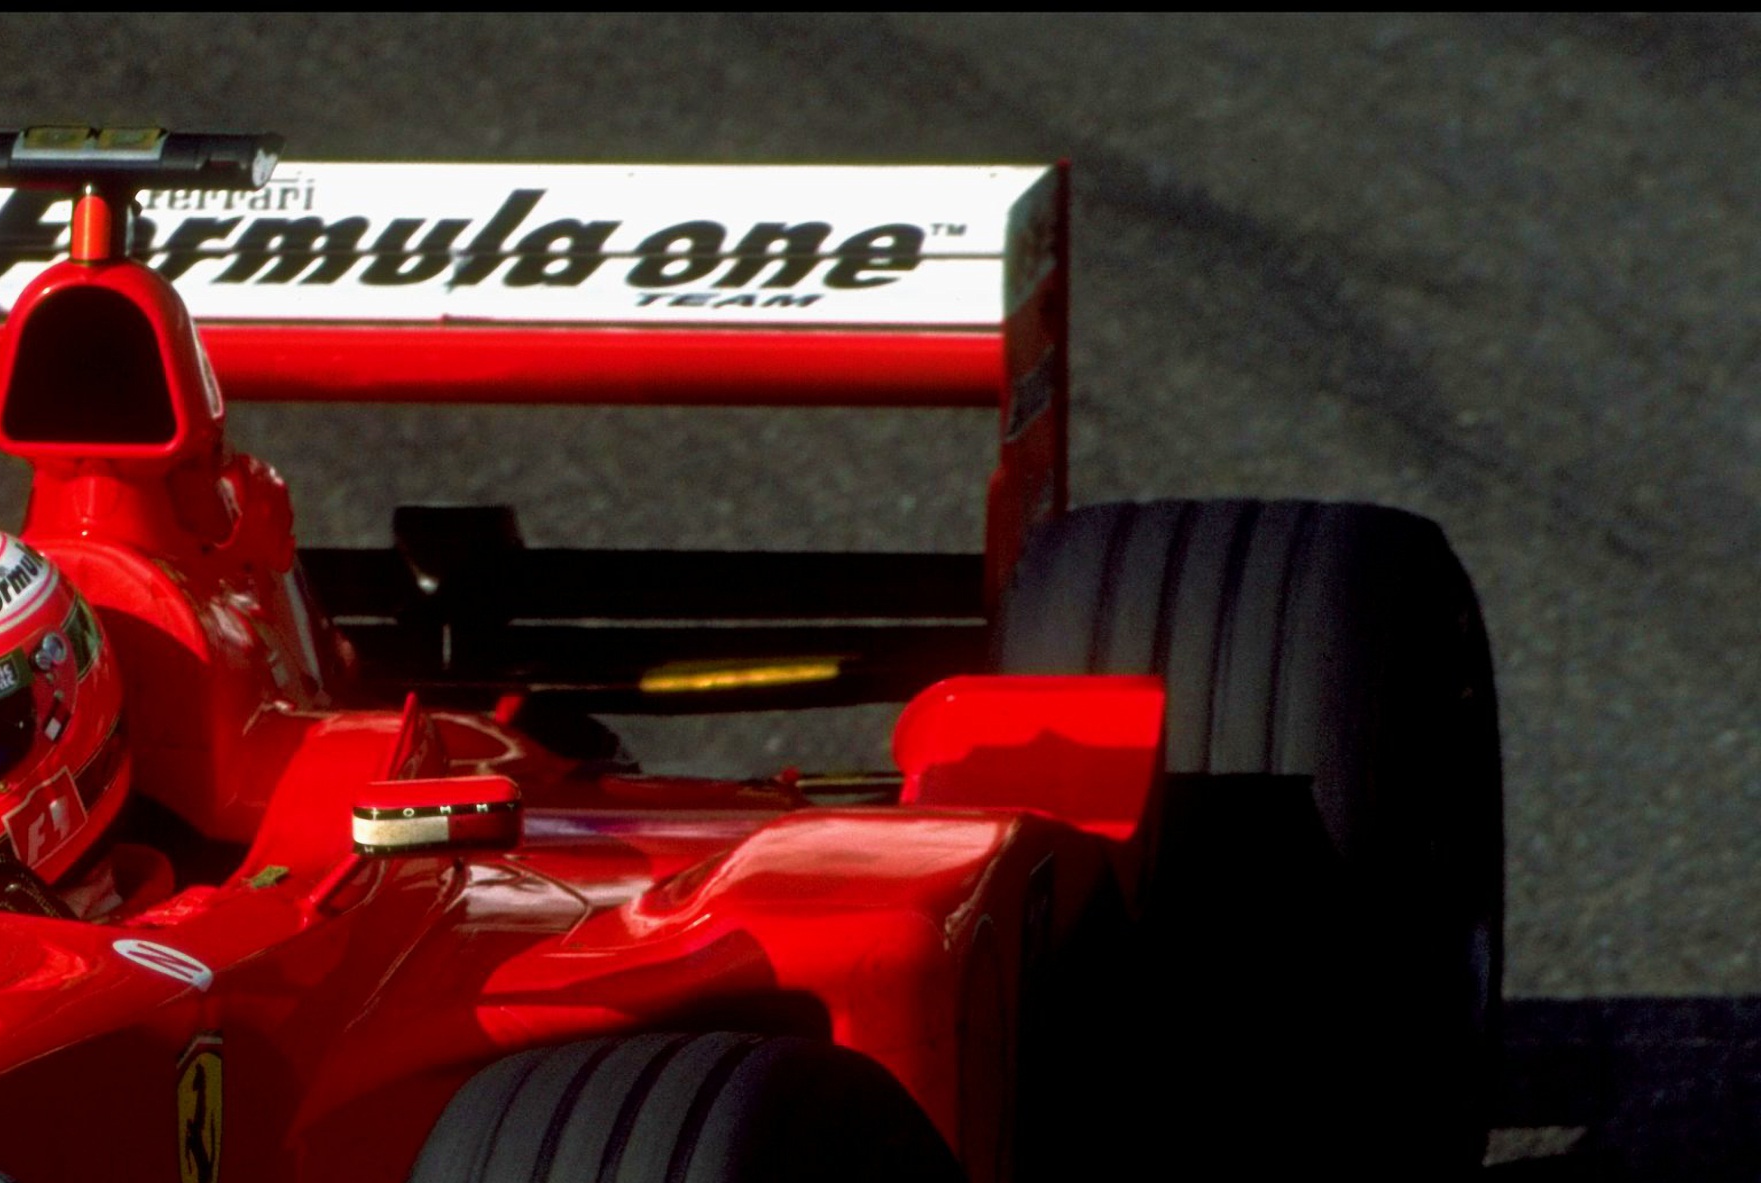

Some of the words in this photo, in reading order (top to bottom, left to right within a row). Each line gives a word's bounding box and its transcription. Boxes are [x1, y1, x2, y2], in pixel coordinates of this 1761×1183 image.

[625, 220, 926, 290] one
[635, 292, 826, 308] TEAM
[371, 803, 515, 818] TOMMY
